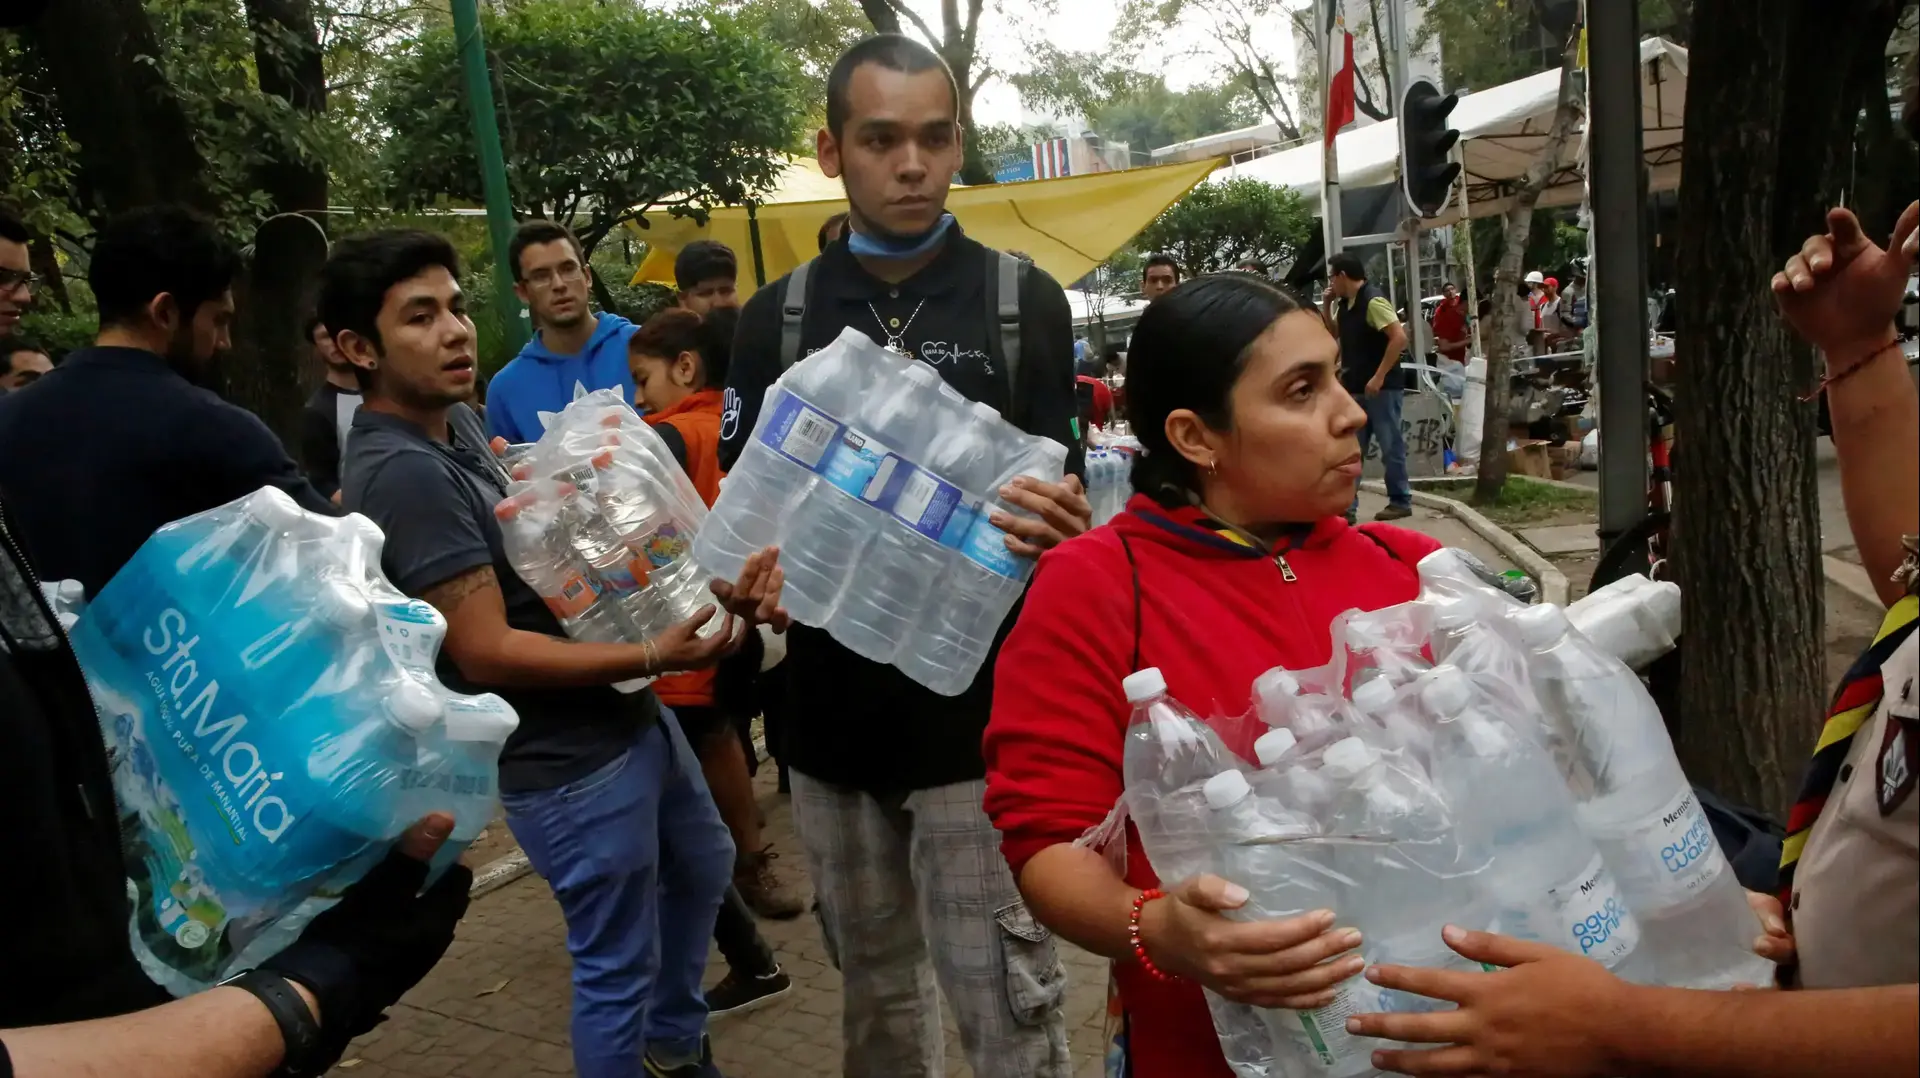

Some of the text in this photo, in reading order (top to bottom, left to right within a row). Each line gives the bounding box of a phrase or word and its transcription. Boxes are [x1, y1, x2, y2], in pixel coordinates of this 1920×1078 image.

[145, 671, 165, 701] AGUA
[172, 730, 201, 764] PURA
[199, 763, 216, 781] DE
[211, 780, 249, 842] MANANTIAL
